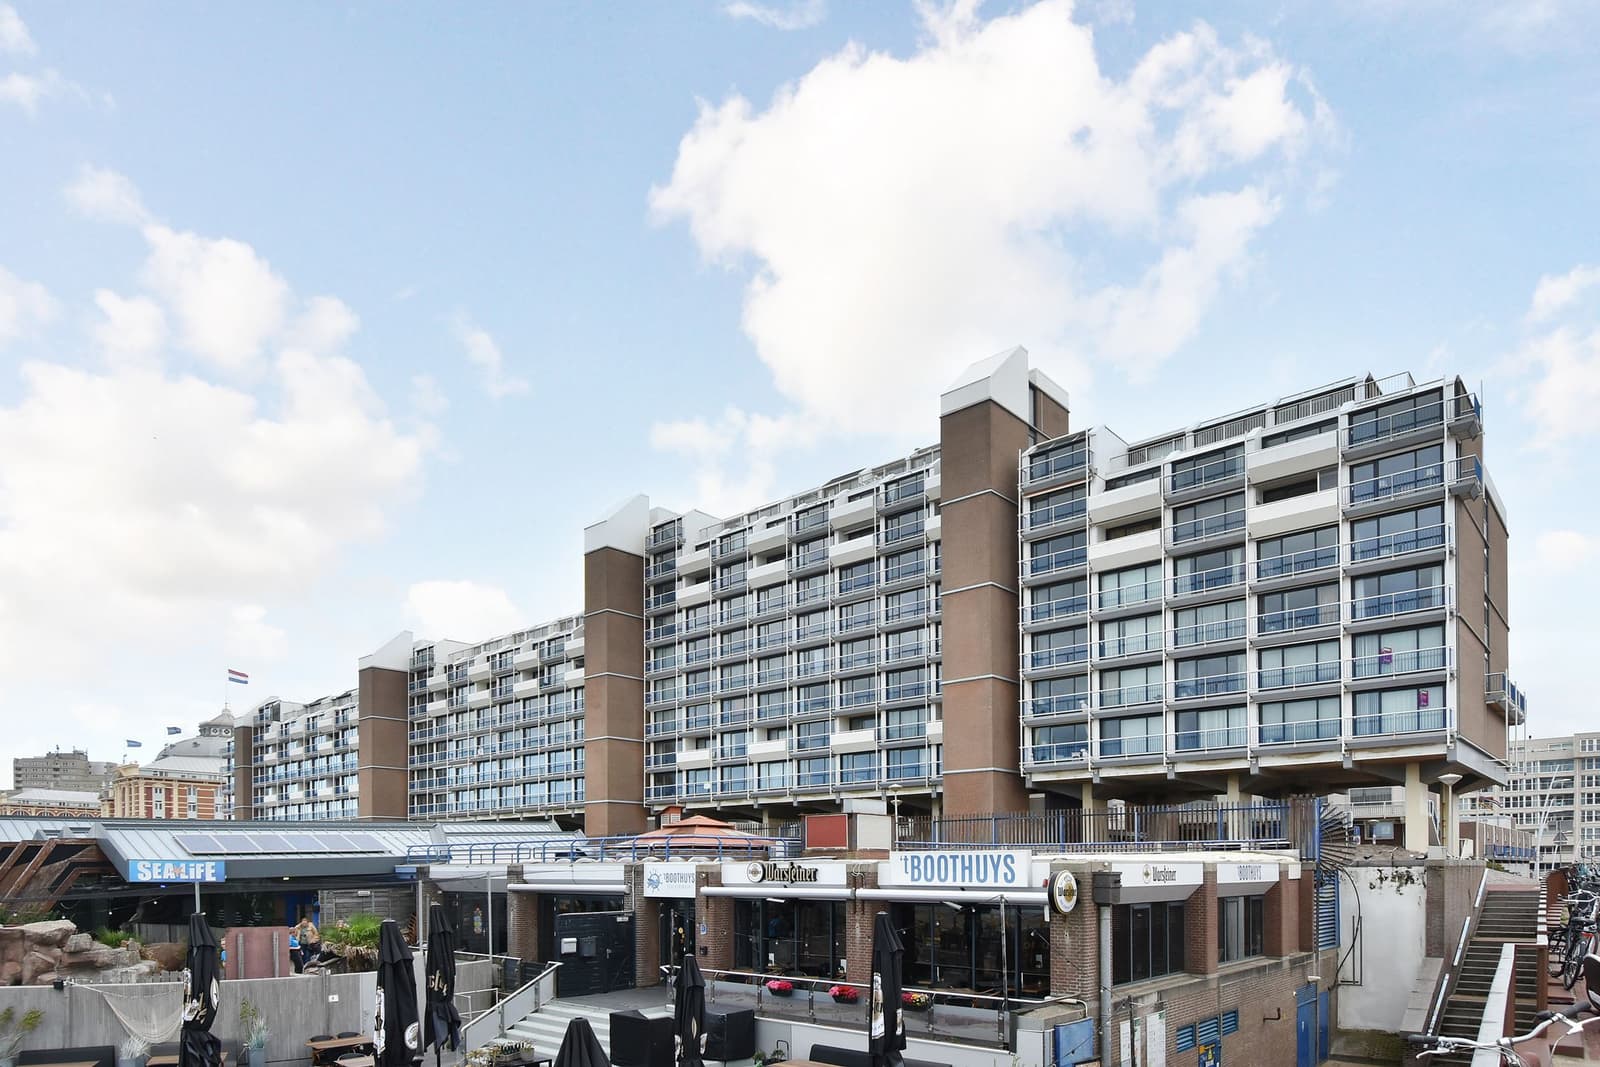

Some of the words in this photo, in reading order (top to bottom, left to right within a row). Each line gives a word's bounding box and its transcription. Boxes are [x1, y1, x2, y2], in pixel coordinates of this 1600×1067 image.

[137, 861, 175, 881] SEA
[765, 862, 818, 884] Warsteiner
[910, 854, 1016, 883] BOOTHUYS
